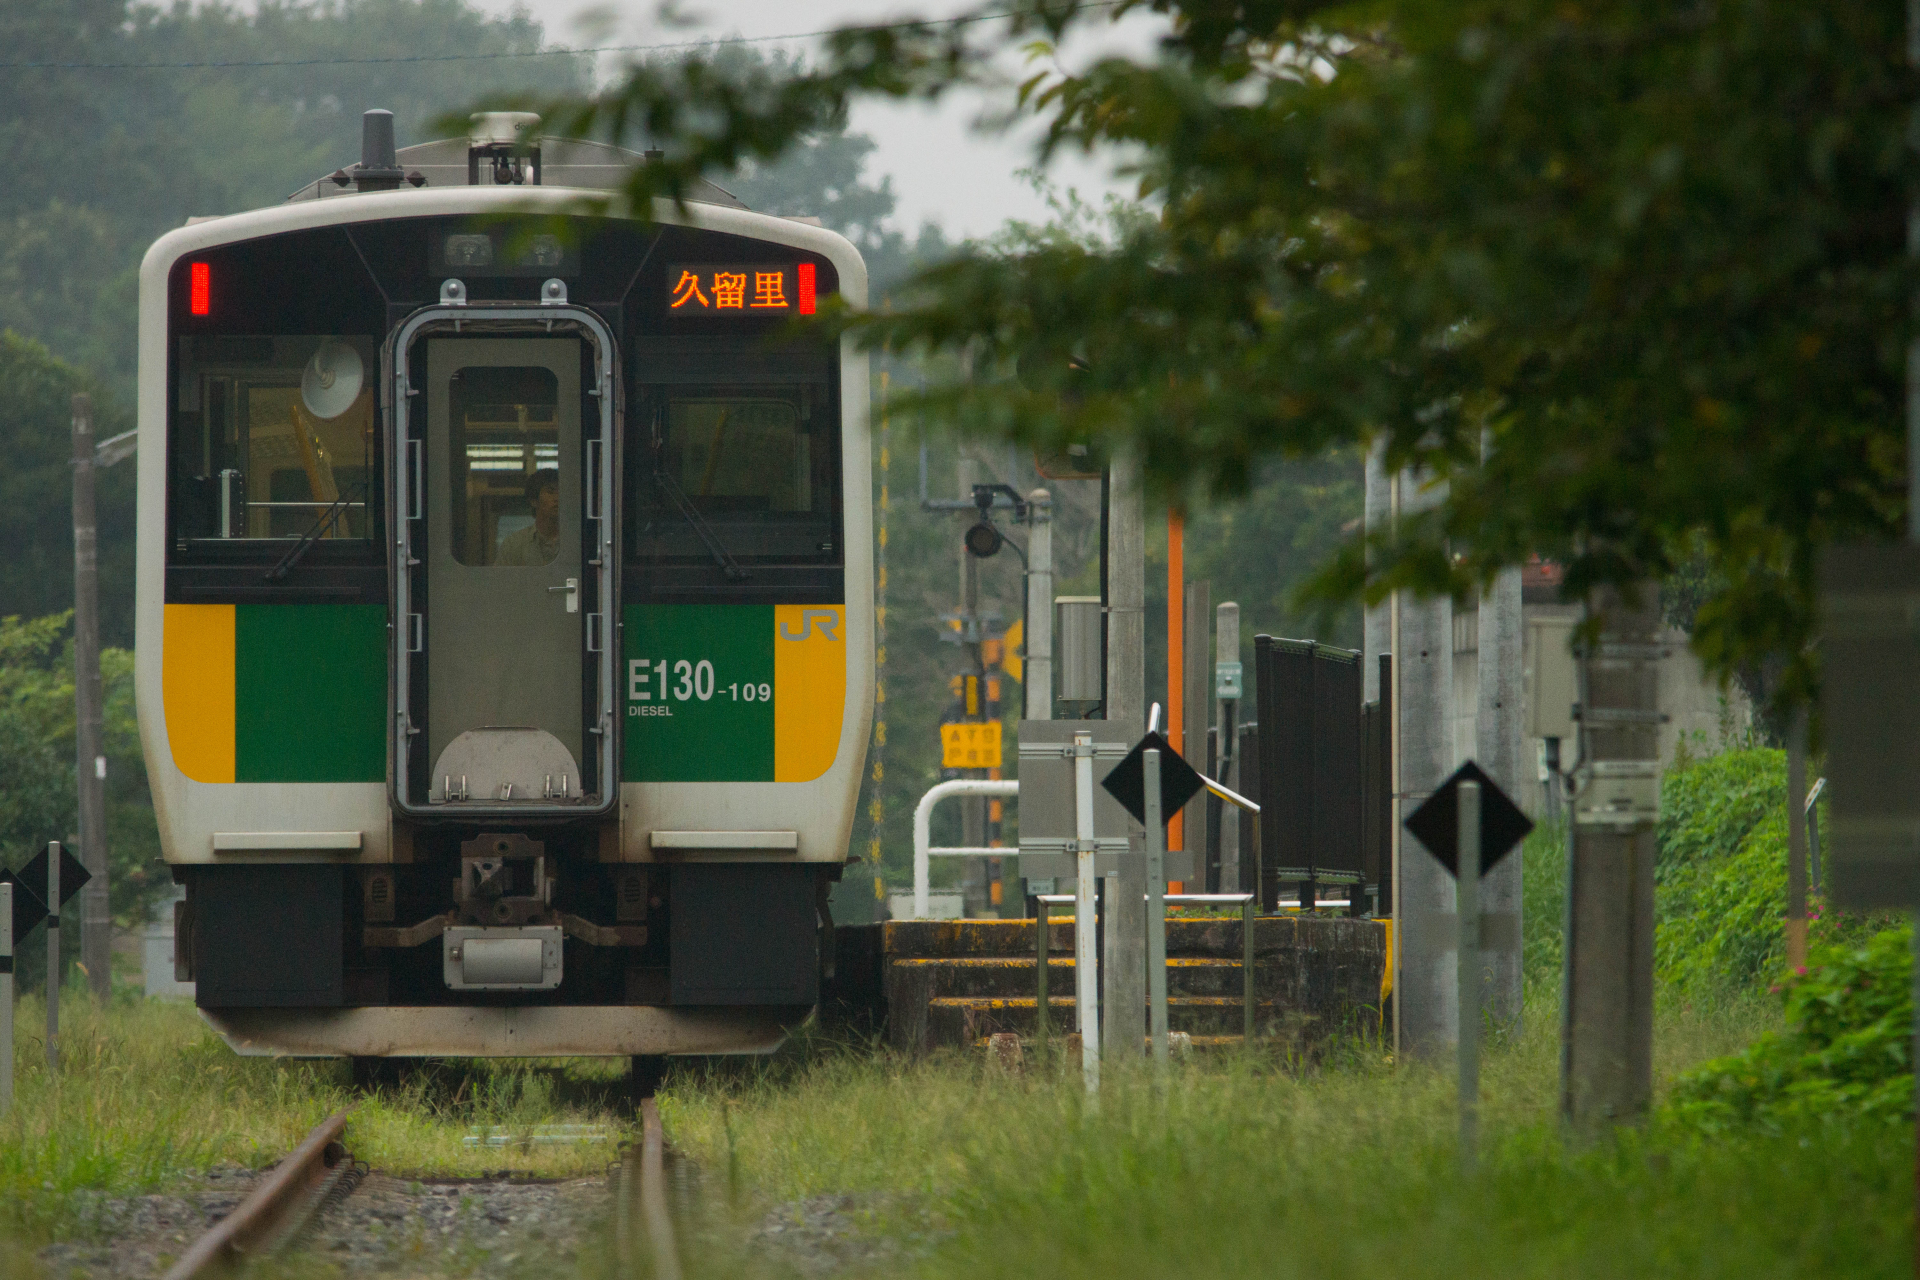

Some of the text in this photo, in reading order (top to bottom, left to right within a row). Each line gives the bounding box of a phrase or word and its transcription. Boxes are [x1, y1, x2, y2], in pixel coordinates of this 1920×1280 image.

[671, 270, 789, 309] 久留里
[780, 609, 839, 641] JR
[628, 706, 673, 716] DIESEL
